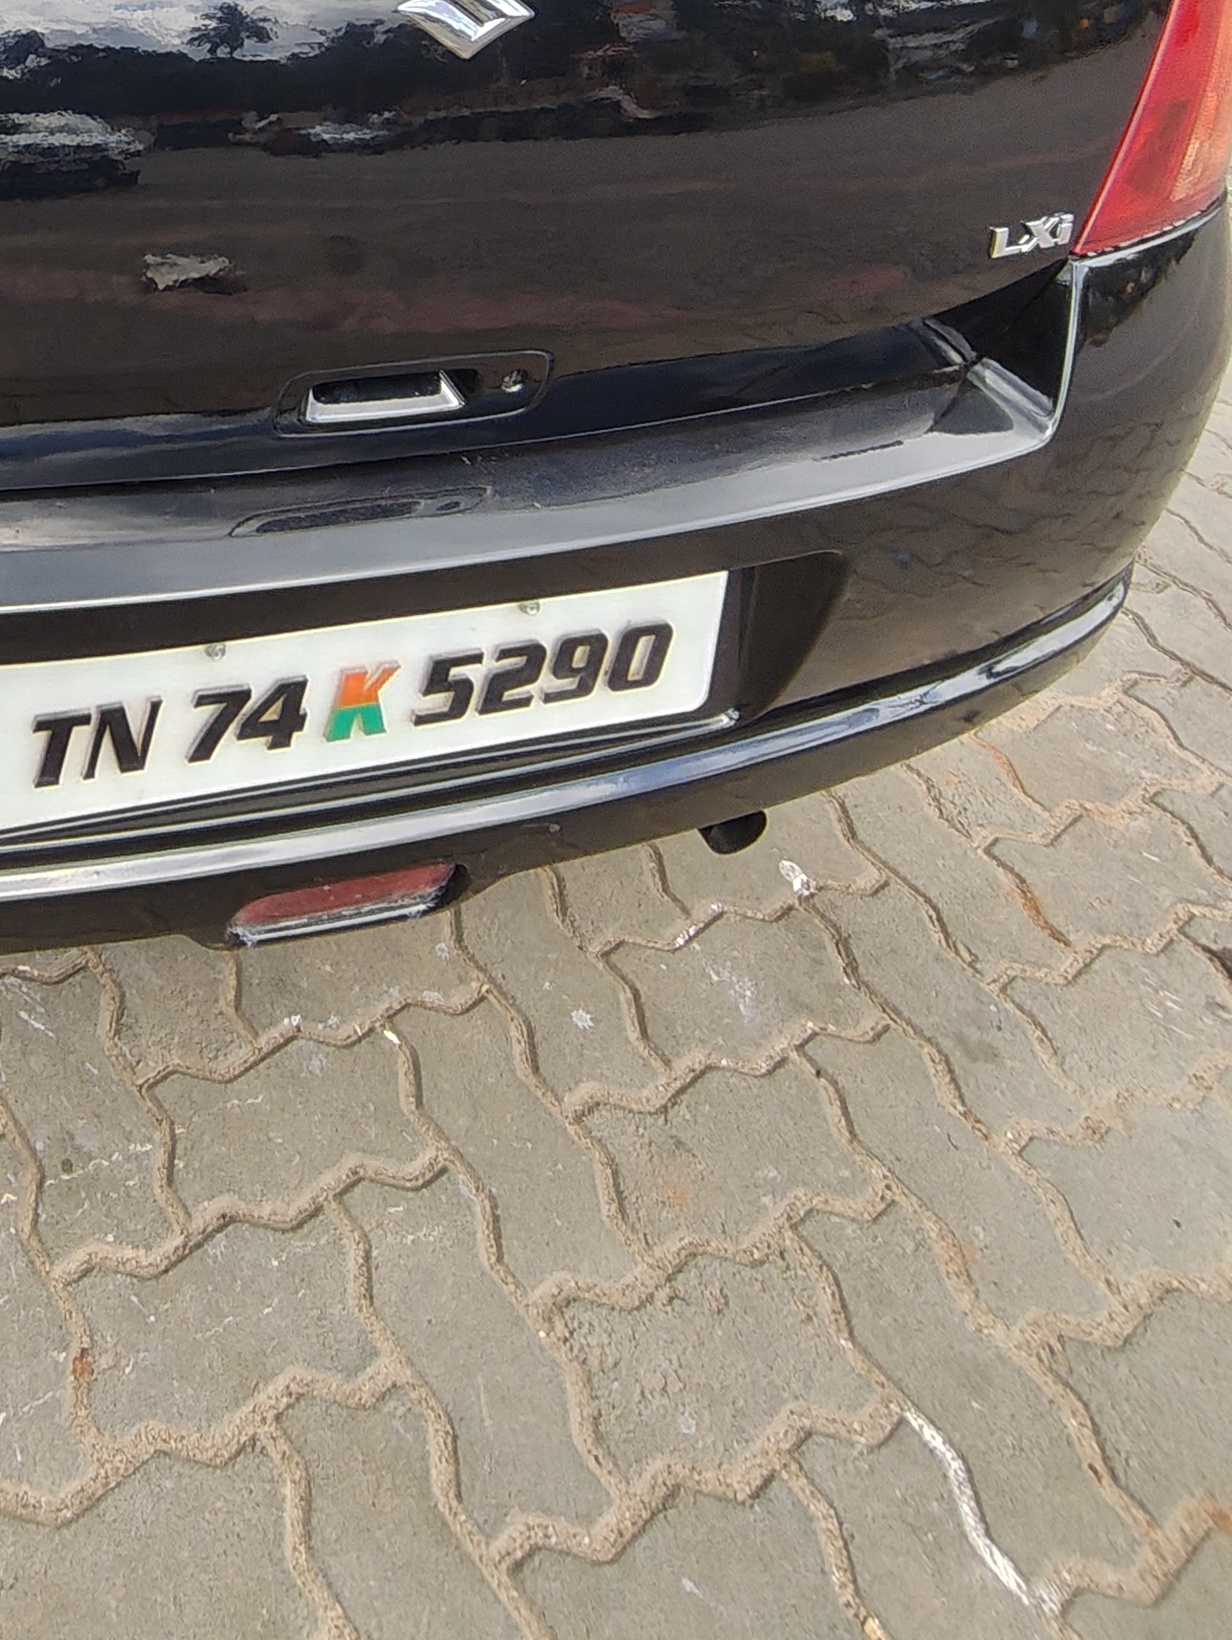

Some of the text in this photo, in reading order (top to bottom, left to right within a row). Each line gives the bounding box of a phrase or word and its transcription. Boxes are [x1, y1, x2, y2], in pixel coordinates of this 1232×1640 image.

[32, 620, 676, 789] TN 74 K 5290
